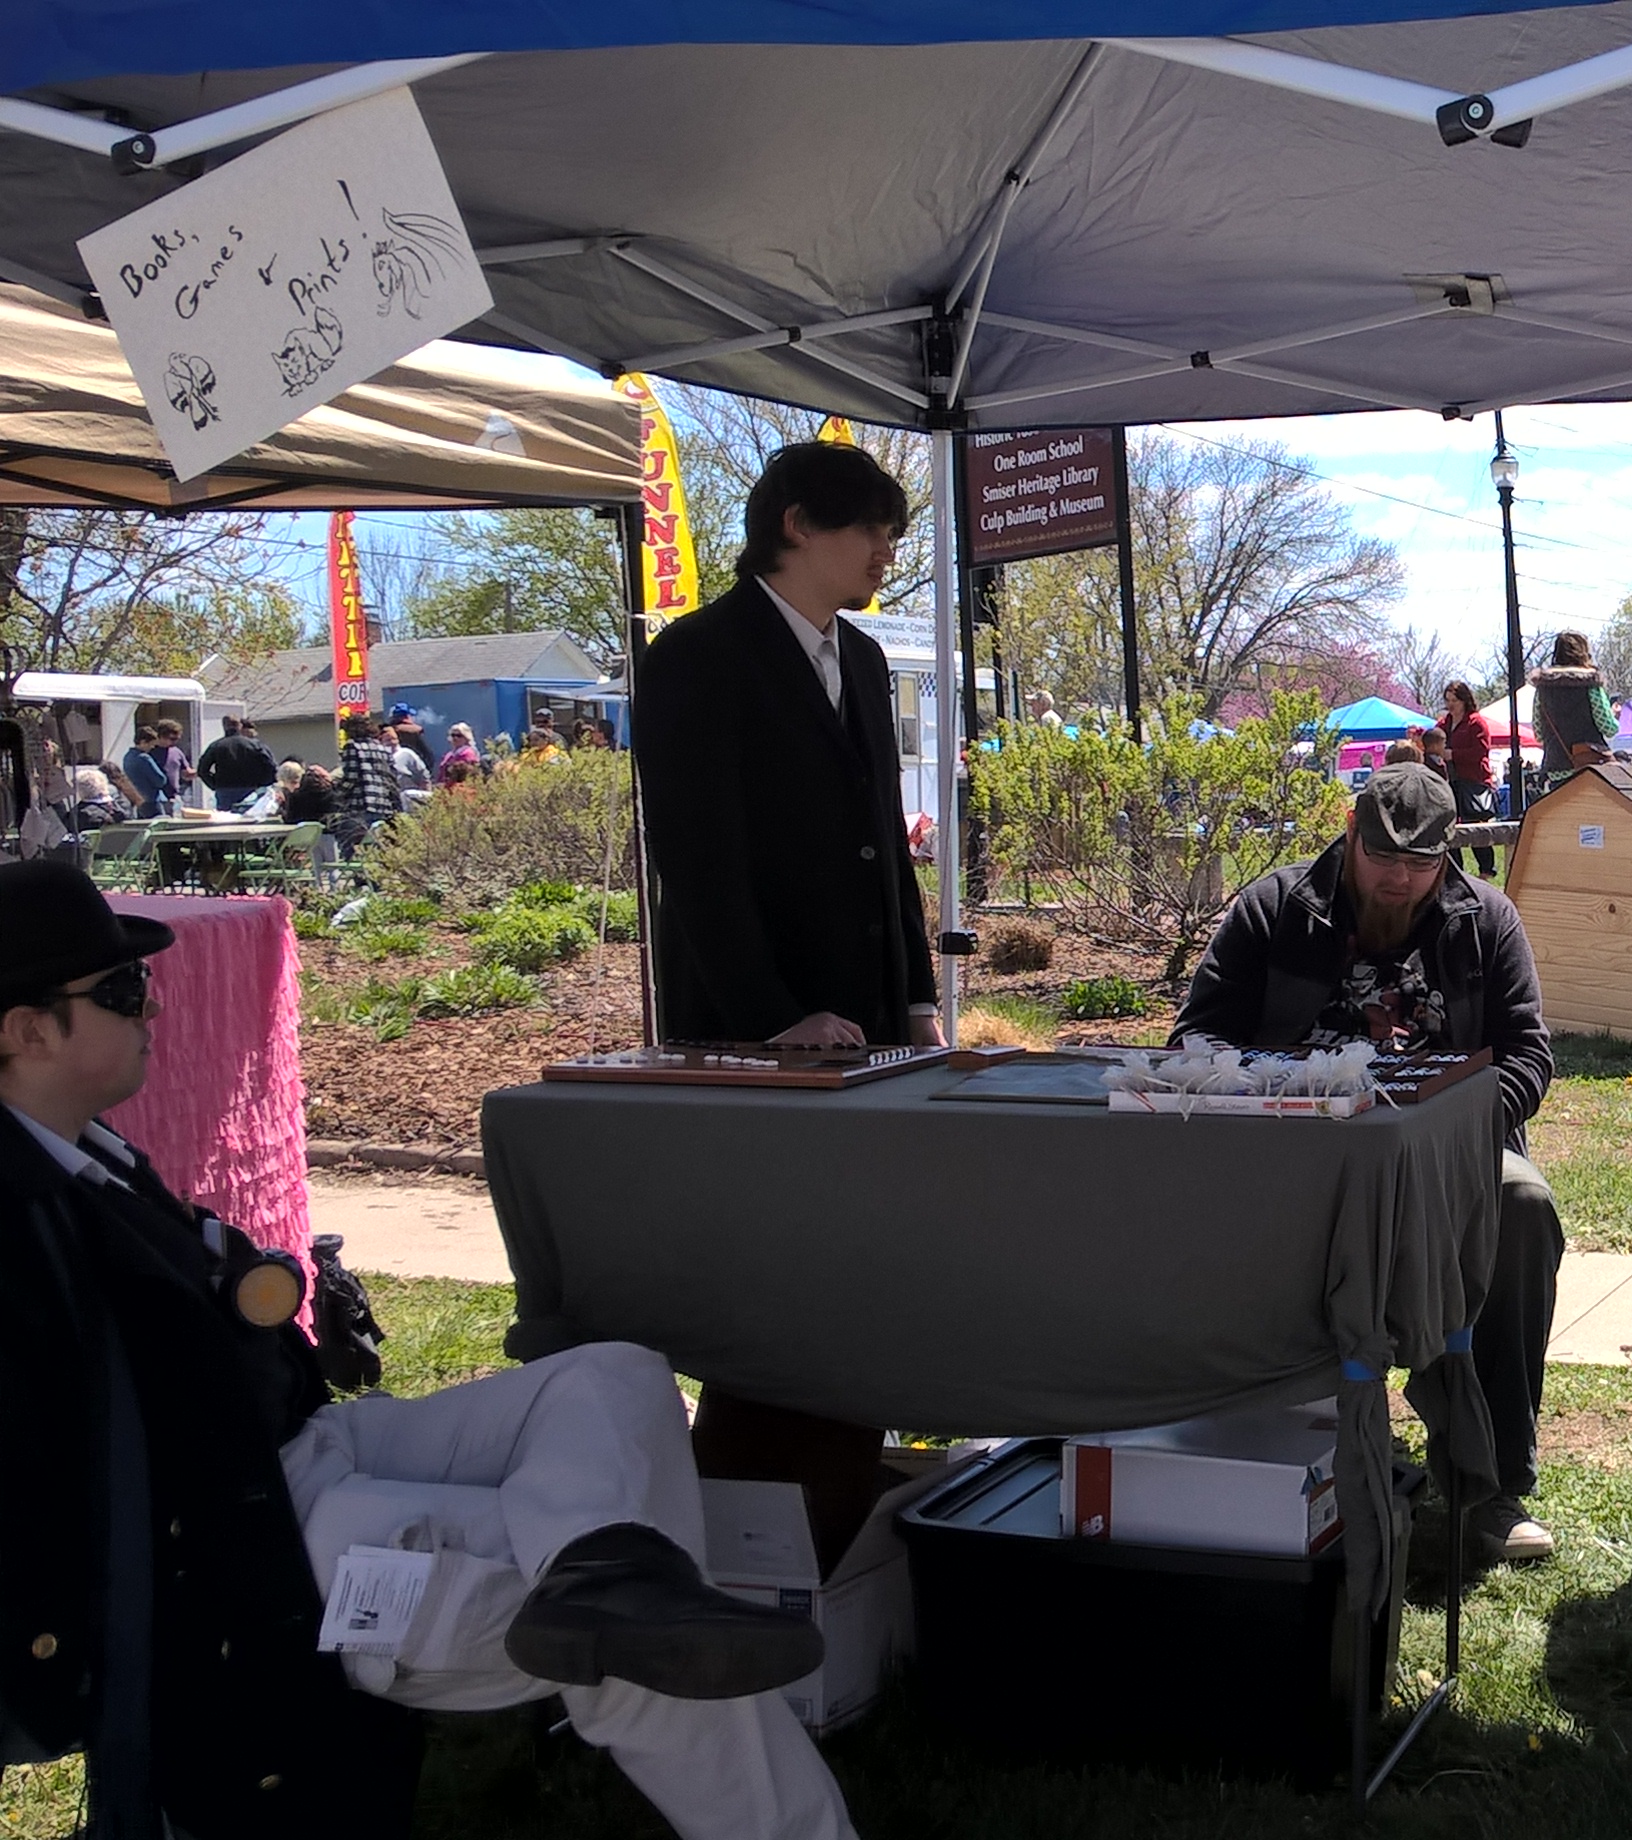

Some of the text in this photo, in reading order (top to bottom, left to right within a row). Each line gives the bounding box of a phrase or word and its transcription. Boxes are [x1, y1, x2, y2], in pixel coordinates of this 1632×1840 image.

[119, 229, 200, 299] Books,
[175, 225, 243, 319] Games
[993, 455, 1016, 473] One
[1017, 446, 1047, 467] Room
[1048, 434, 1084, 460] School
[982, 465, 1099, 503] Smiser Heritage Library
[980, 493, 1105, 534] Culp Building & Museum
